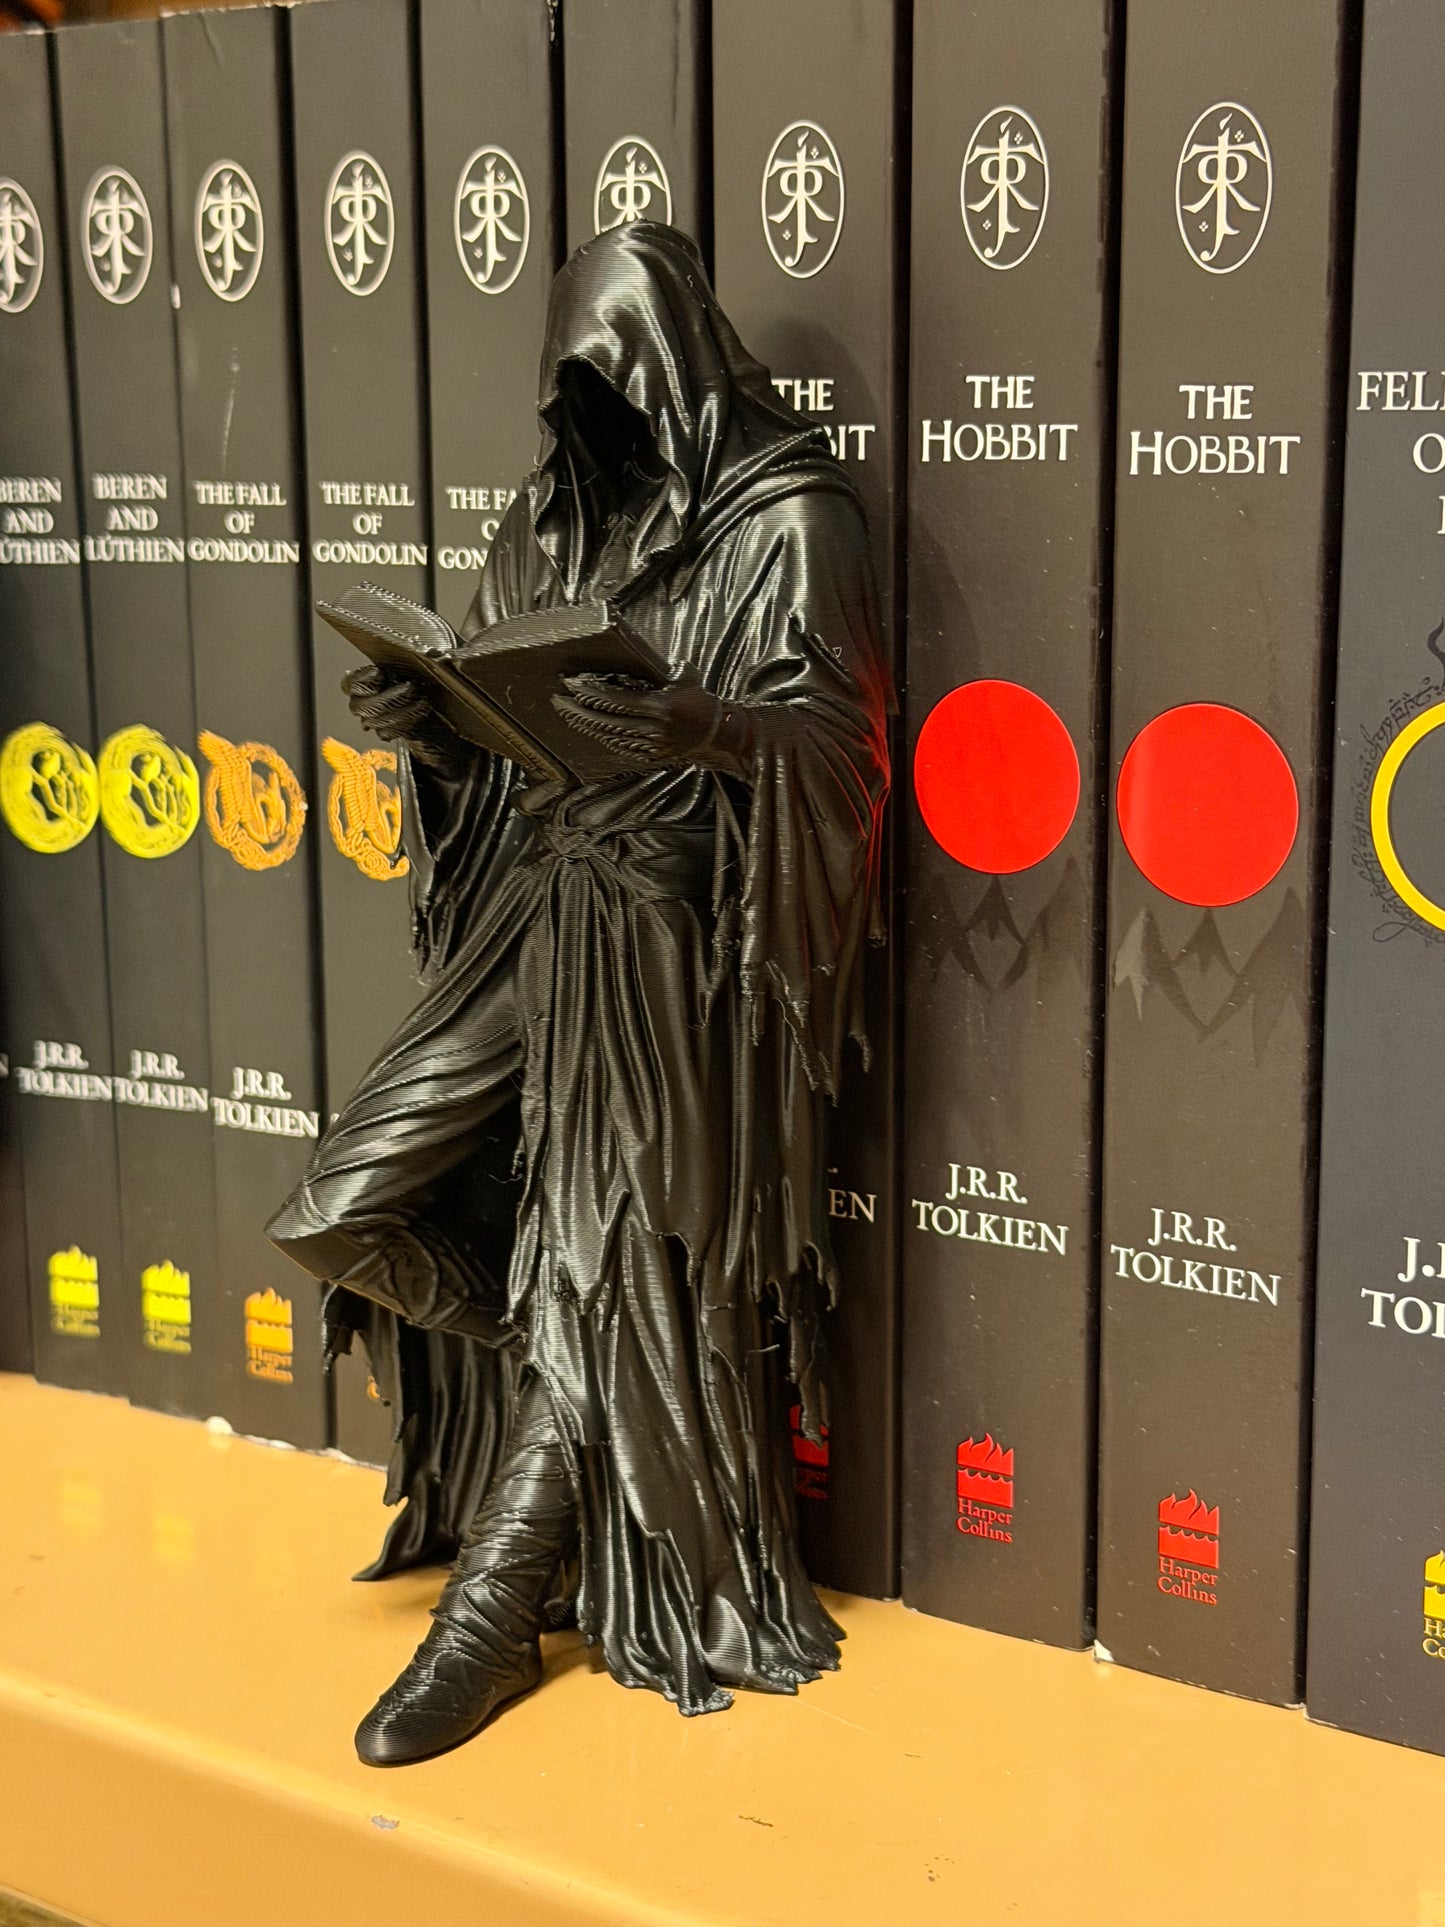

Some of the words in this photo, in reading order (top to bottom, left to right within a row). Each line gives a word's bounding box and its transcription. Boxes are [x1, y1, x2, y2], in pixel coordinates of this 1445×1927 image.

[771, 379, 834, 411] THE
[965, 375, 1035, 409] THE
[1178, 385, 1254, 420] THE
[921, 420, 1079, 462] HOBBIT
[1129, 431, 1301, 475] HOBBIT
[93, 474, 167, 499] BEREN
[195, 481, 235, 504] THE
[236, 483, 287, 506] FALL
[321, 482, 363, 505] THE
[364, 484, 415, 506] FALL
[446, 487, 491, 509] THE
[3, 508, 54, 533] AND
[107, 505, 158, 531] AND
[225, 511, 254, 534] OF
[352, 512, 383, 535] OF
[84, 532, 184, 562] LÚTHIEN
[188, 538, 300, 563] GONDOLIN
[313, 540, 428, 566] GONDOLIN
[16, 1067, 113, 1101] TOLKIEN
[114, 1076, 208, 1112] TOLKIEN
[231, 1066, 292, 1100] J.R.R.
[211, 1097, 319, 1138] TOLKIEN
[945, 1163, 1028, 1204] J.R.R.
[912, 1199, 1069, 1256] TOLKIEN
[1148, 1208, 1237, 1251] J.R.R.
[1110, 1244, 1281, 1306] TOLKIEN
[958, 1497, 1014, 1525] Harper
[957, 1516, 1014, 1544] Collins
[1159, 1556, 1218, 1586] Harper
[1157, 1576, 1218, 1606] Collins
